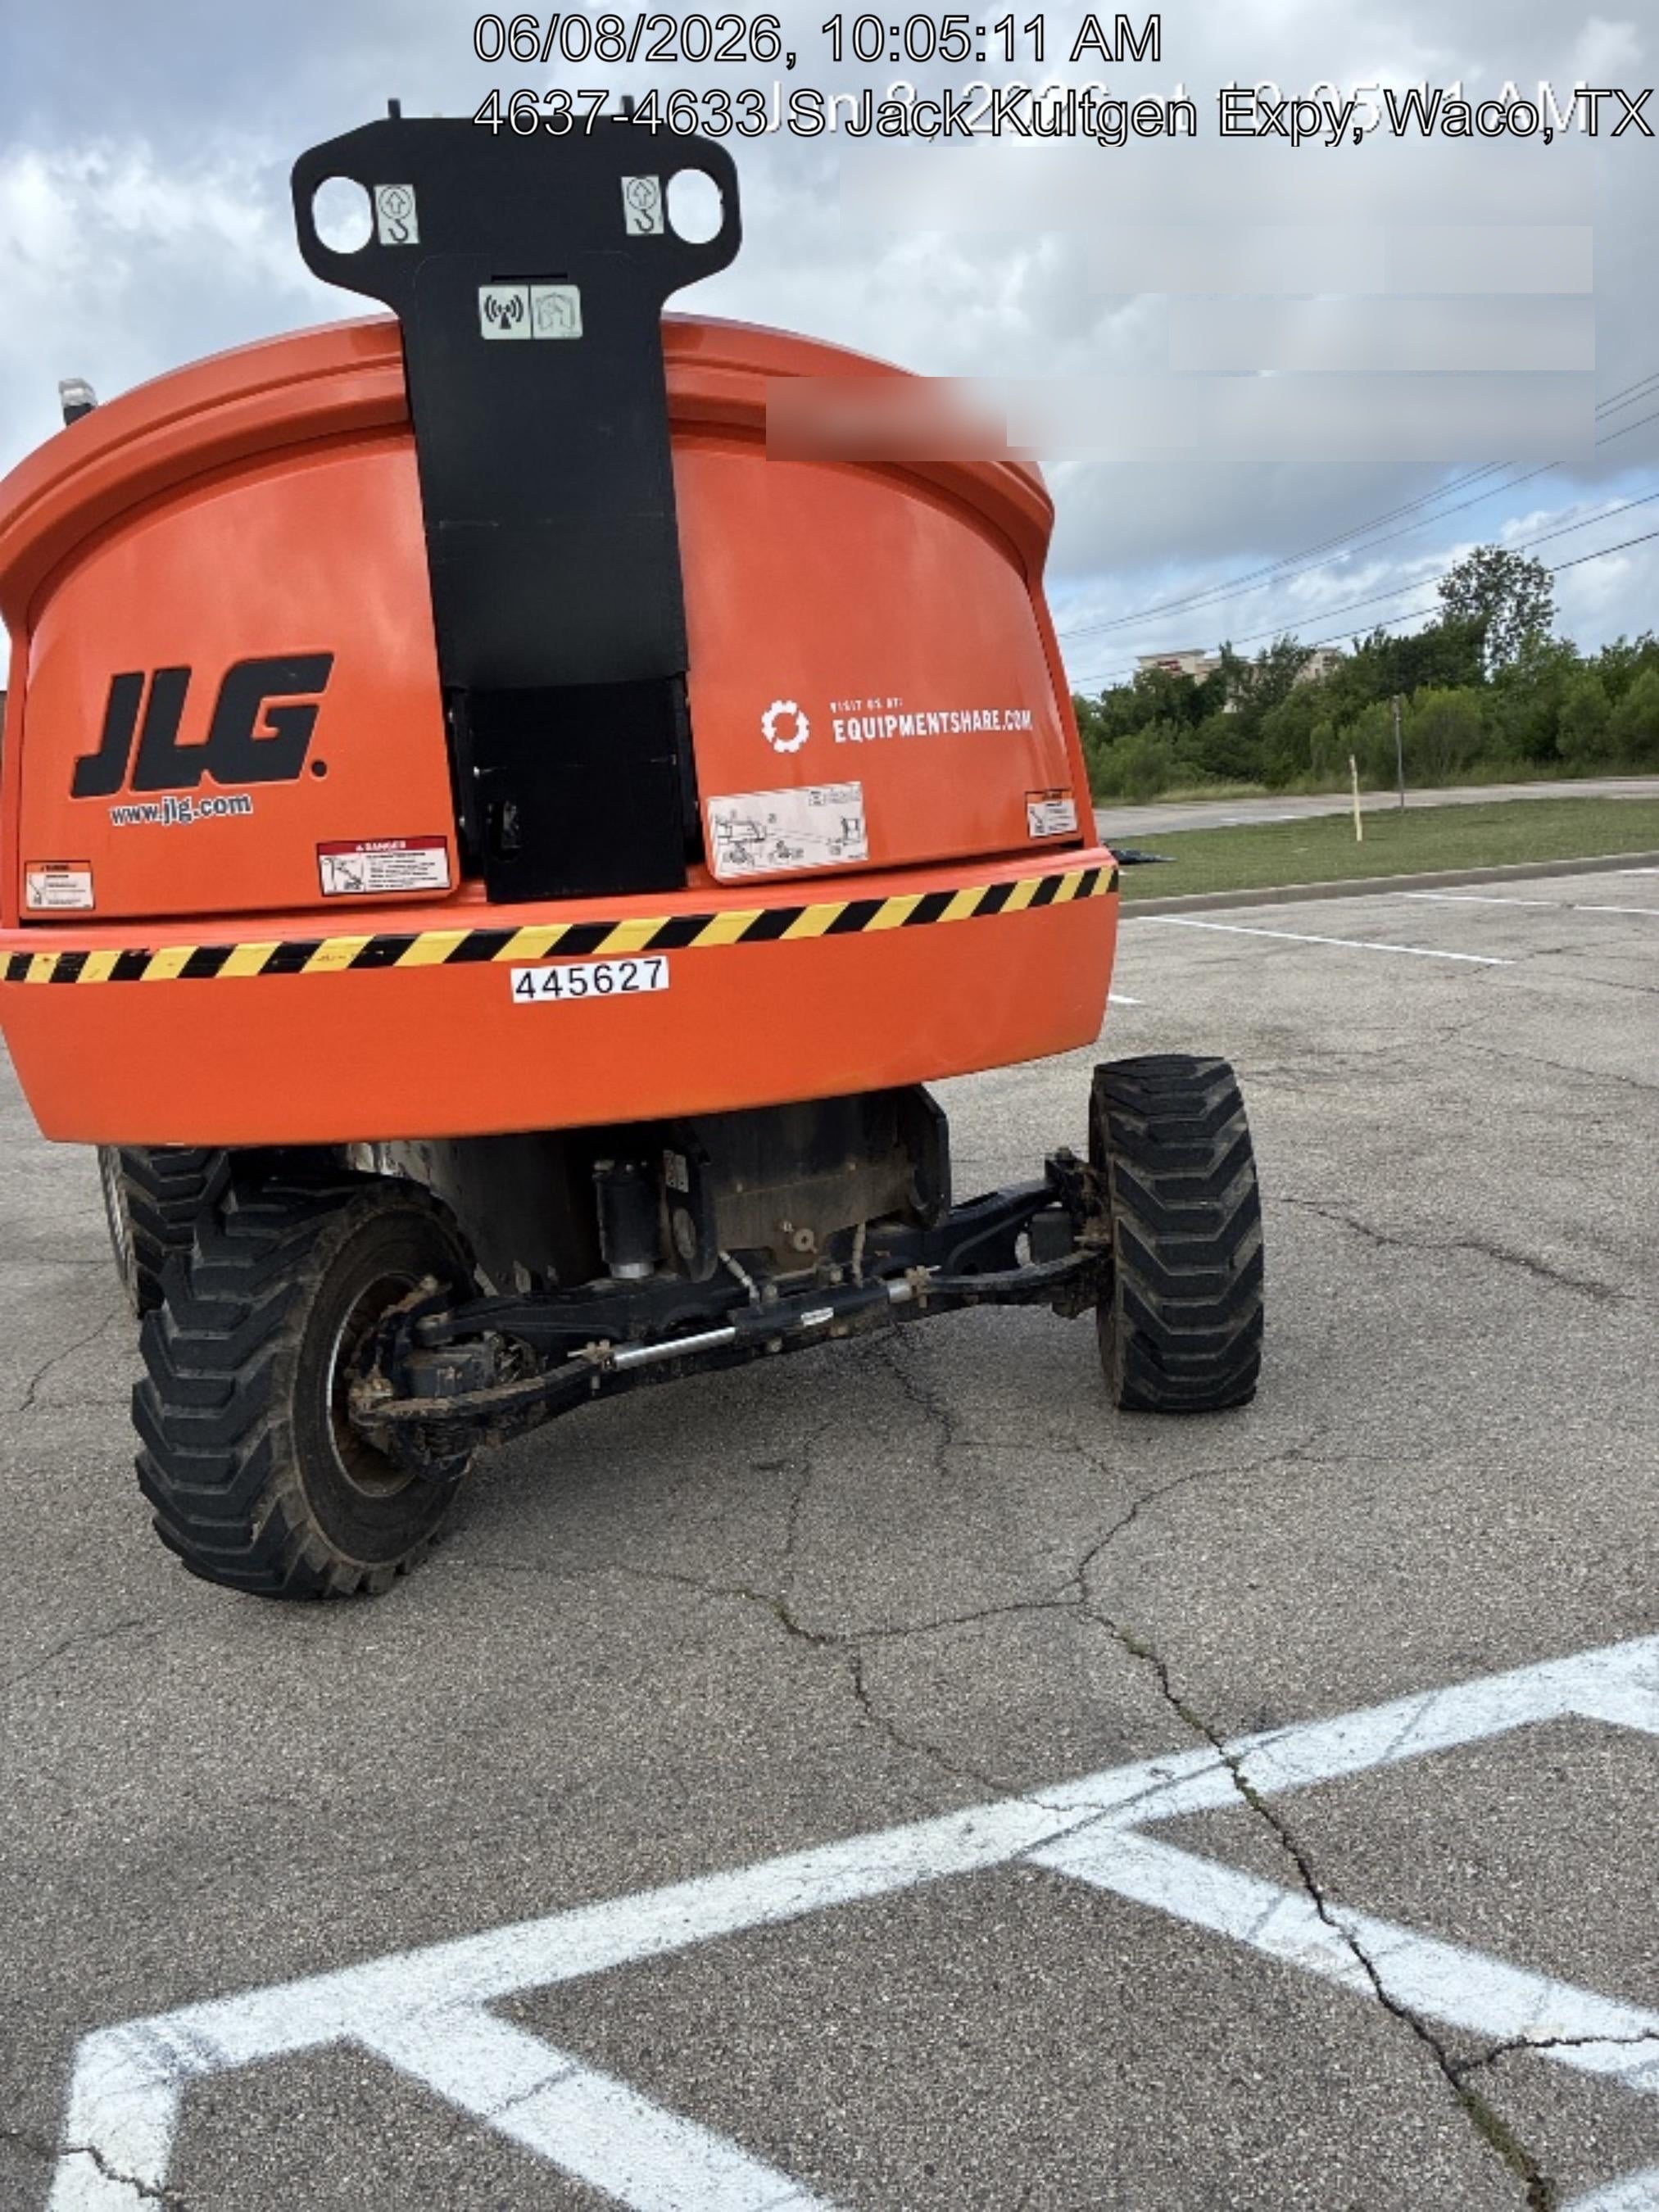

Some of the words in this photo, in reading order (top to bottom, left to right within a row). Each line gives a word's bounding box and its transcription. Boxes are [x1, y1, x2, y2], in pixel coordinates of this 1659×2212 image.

[832, 709, 1033, 743] EQUIPMENTSHARE.COM
[110, 795, 253, 825] www.jlg.com
[514, 959, 662, 999] 445627
